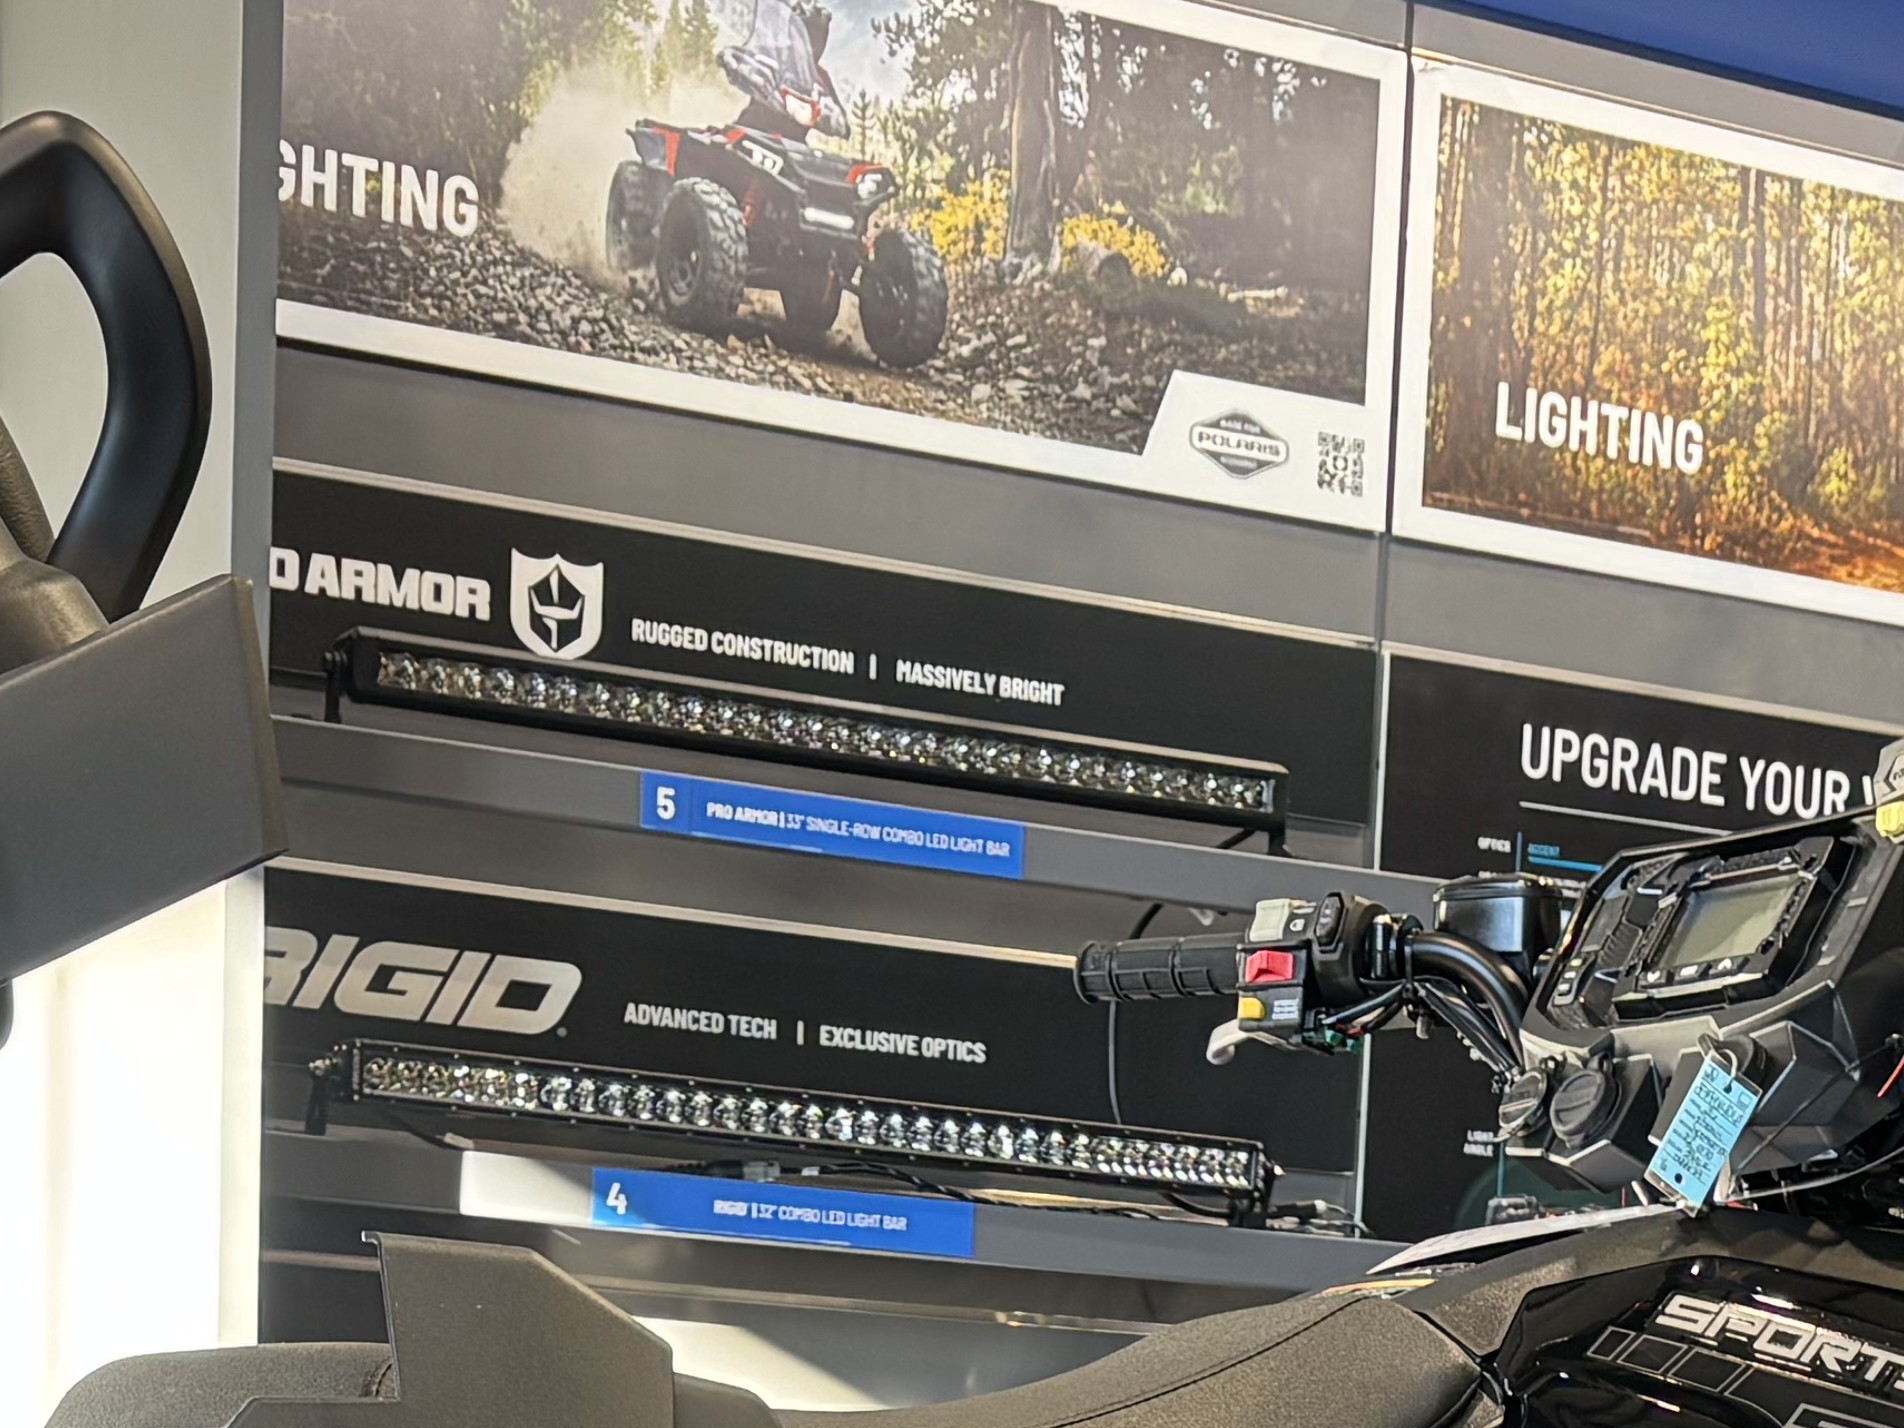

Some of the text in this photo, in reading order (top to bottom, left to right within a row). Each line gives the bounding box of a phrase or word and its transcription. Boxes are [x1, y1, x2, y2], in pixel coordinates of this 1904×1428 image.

[1198, 431, 1281, 457] POLARIS
[1495, 381, 1704, 475] LIGHTING
[304, 552, 491, 621] ARMOR
[631, 618, 855, 674] RUGGED CONSTRUCTION
[896, 659, 1065, 706] MASSIVELY BRIGHT
[1520, 722, 1728, 808] UPGRADE
[1739, 756, 1850, 820] YOUR
[655, 786, 676, 820] 5
[706, 801, 733, 821] PRO
[734, 809, 778, 828] ARMOR
[882, 826, 924, 847] COMBO
[925, 832, 949, 851] LED
[950, 836, 984, 855] LIGHT
[985, 840, 1011, 858] BAR
[624, 1001, 777, 1041] ADVANCED TECH
[819, 1024, 987, 1065] EXCLUSIVE OPTICS
[606, 1181, 627, 1215] 4
[822, 1210, 845, 1226] LED
